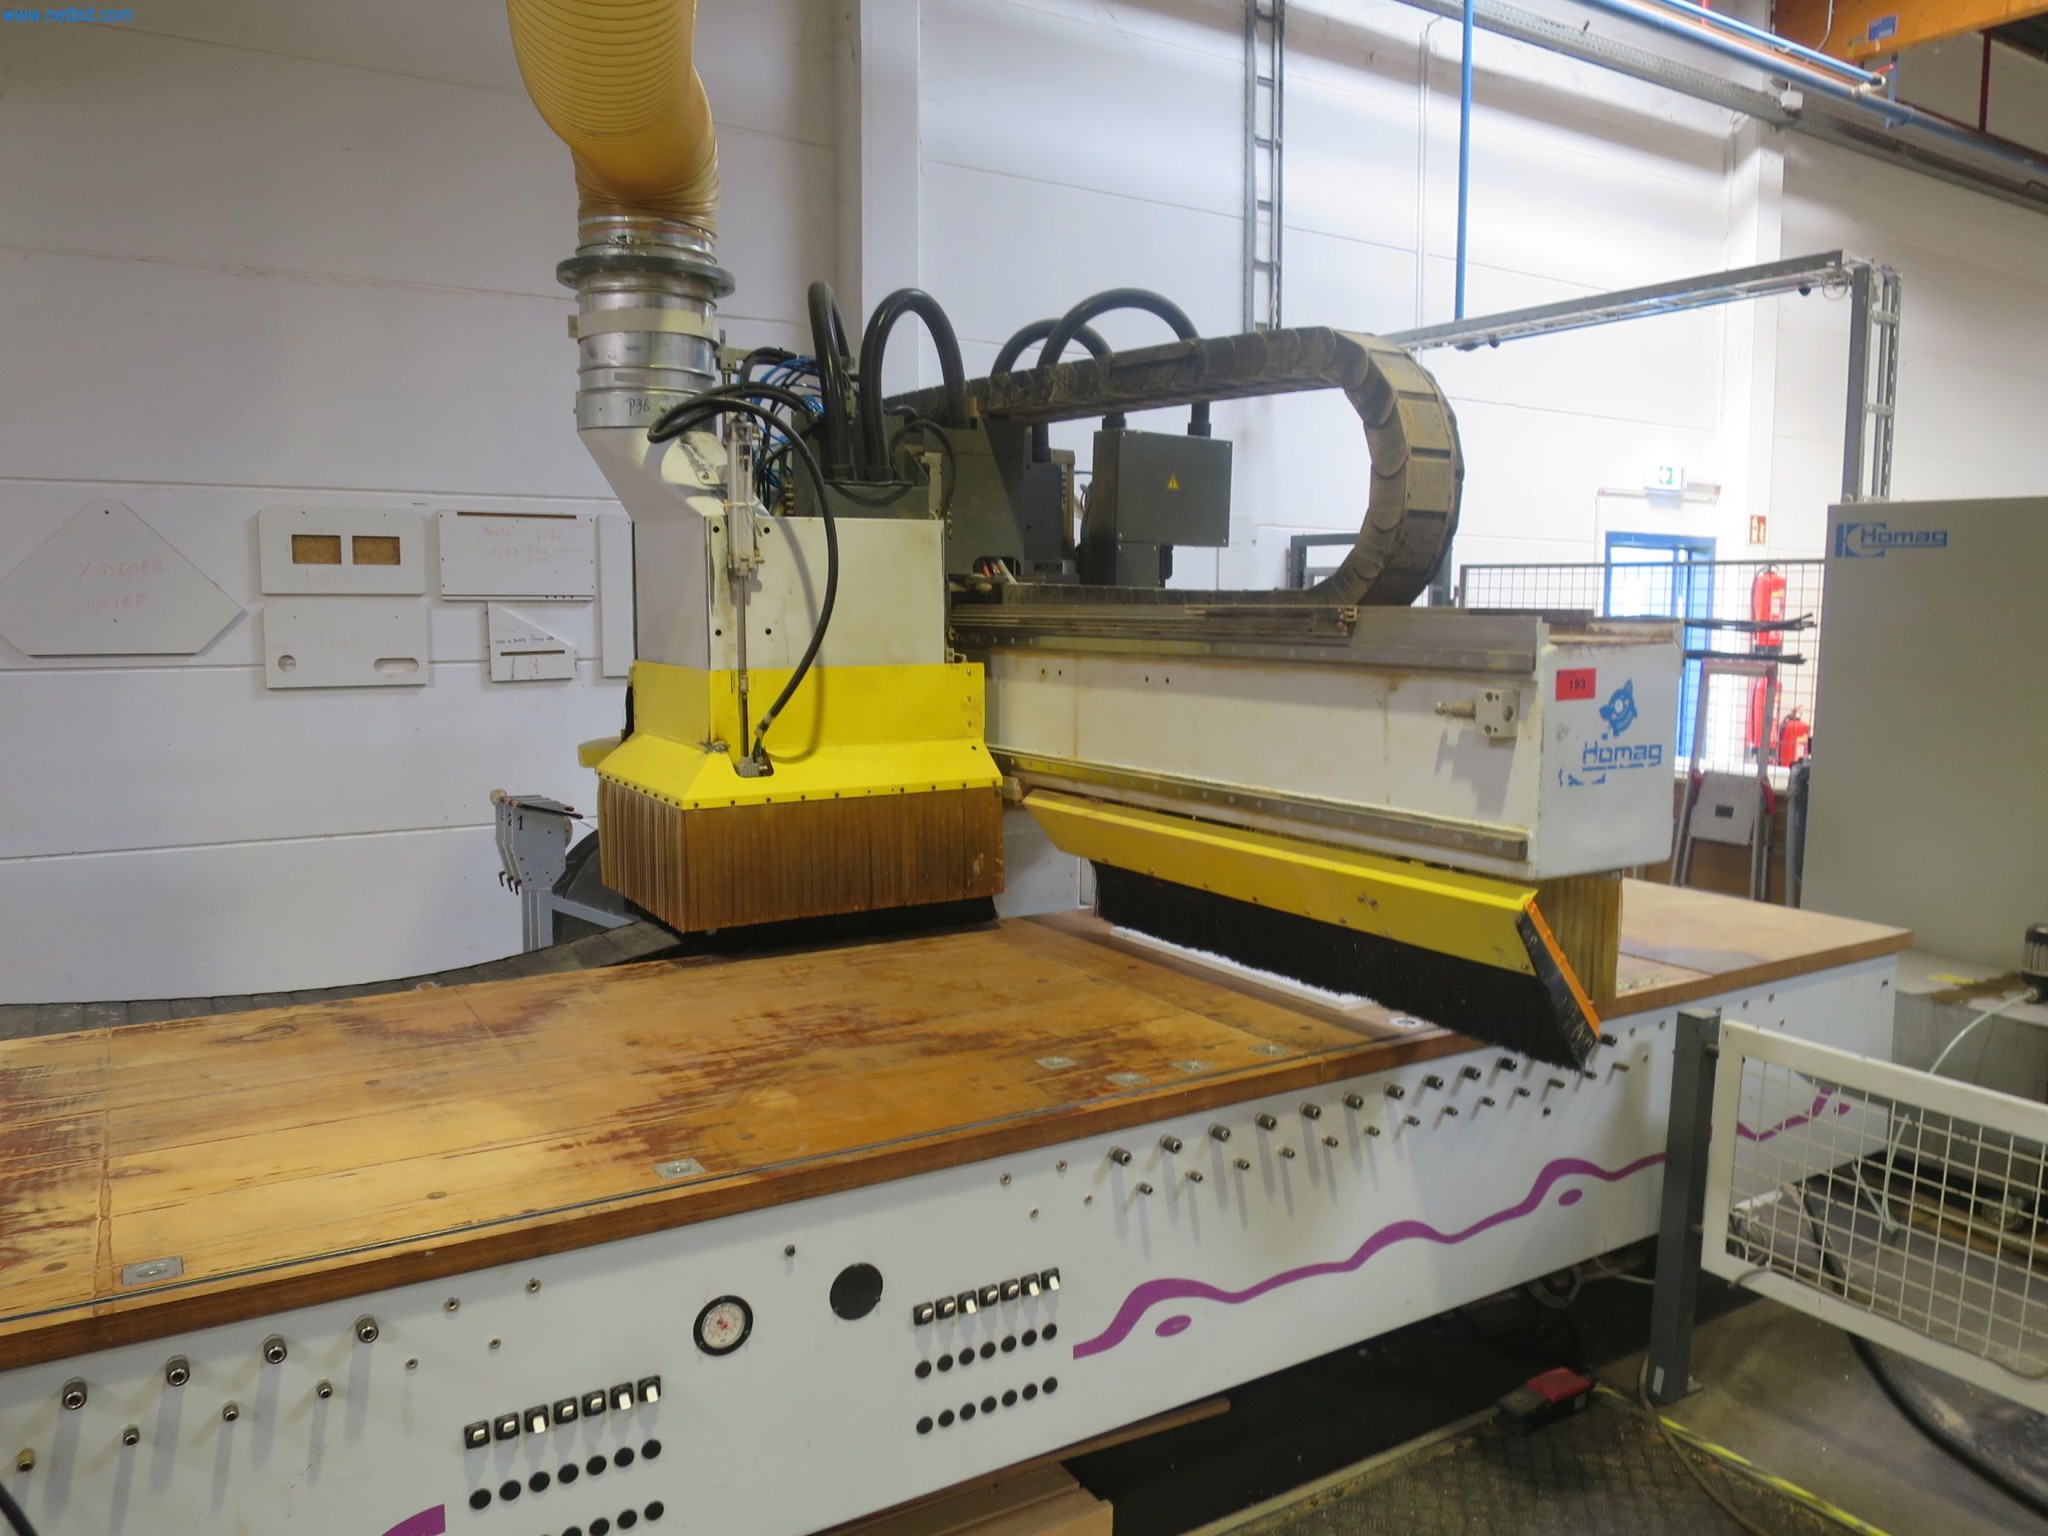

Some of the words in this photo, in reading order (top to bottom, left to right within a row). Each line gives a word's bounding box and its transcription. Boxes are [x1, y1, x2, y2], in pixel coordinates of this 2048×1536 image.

[628, 399, 650, 416] P36
[1860, 526, 1948, 548] Homag
[1582, 741, 1662, 766] Homag
[517, 815, 524, 831] 1
